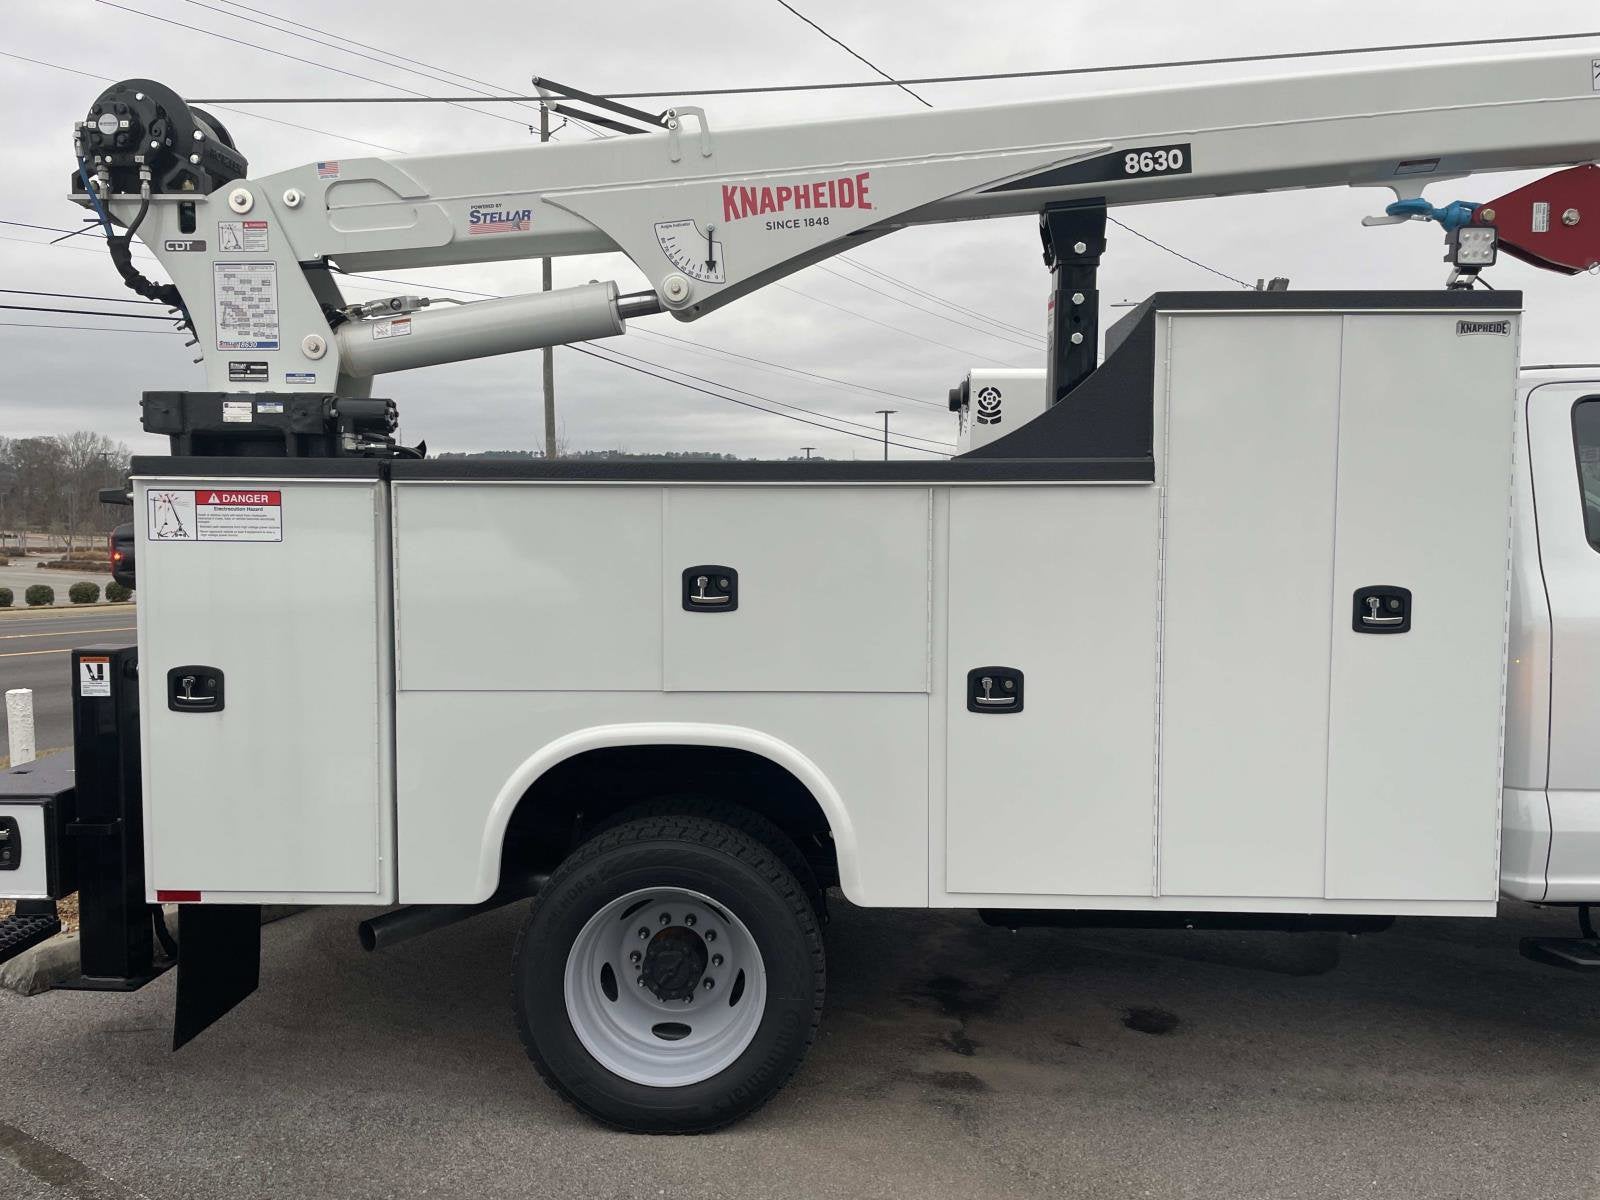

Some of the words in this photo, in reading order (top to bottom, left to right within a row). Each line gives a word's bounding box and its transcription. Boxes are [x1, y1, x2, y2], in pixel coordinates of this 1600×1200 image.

[1125, 149, 1183, 174] 8630
[721, 172, 872, 222] KNAPHEIDE
[766, 219, 800, 230] SINCE
[804, 216, 830, 228] 1848
[166, 241, 193, 250] CDT
[1460, 322, 1507, 335] KNAPHEIDE
[222, 494, 269, 503] DANGER
